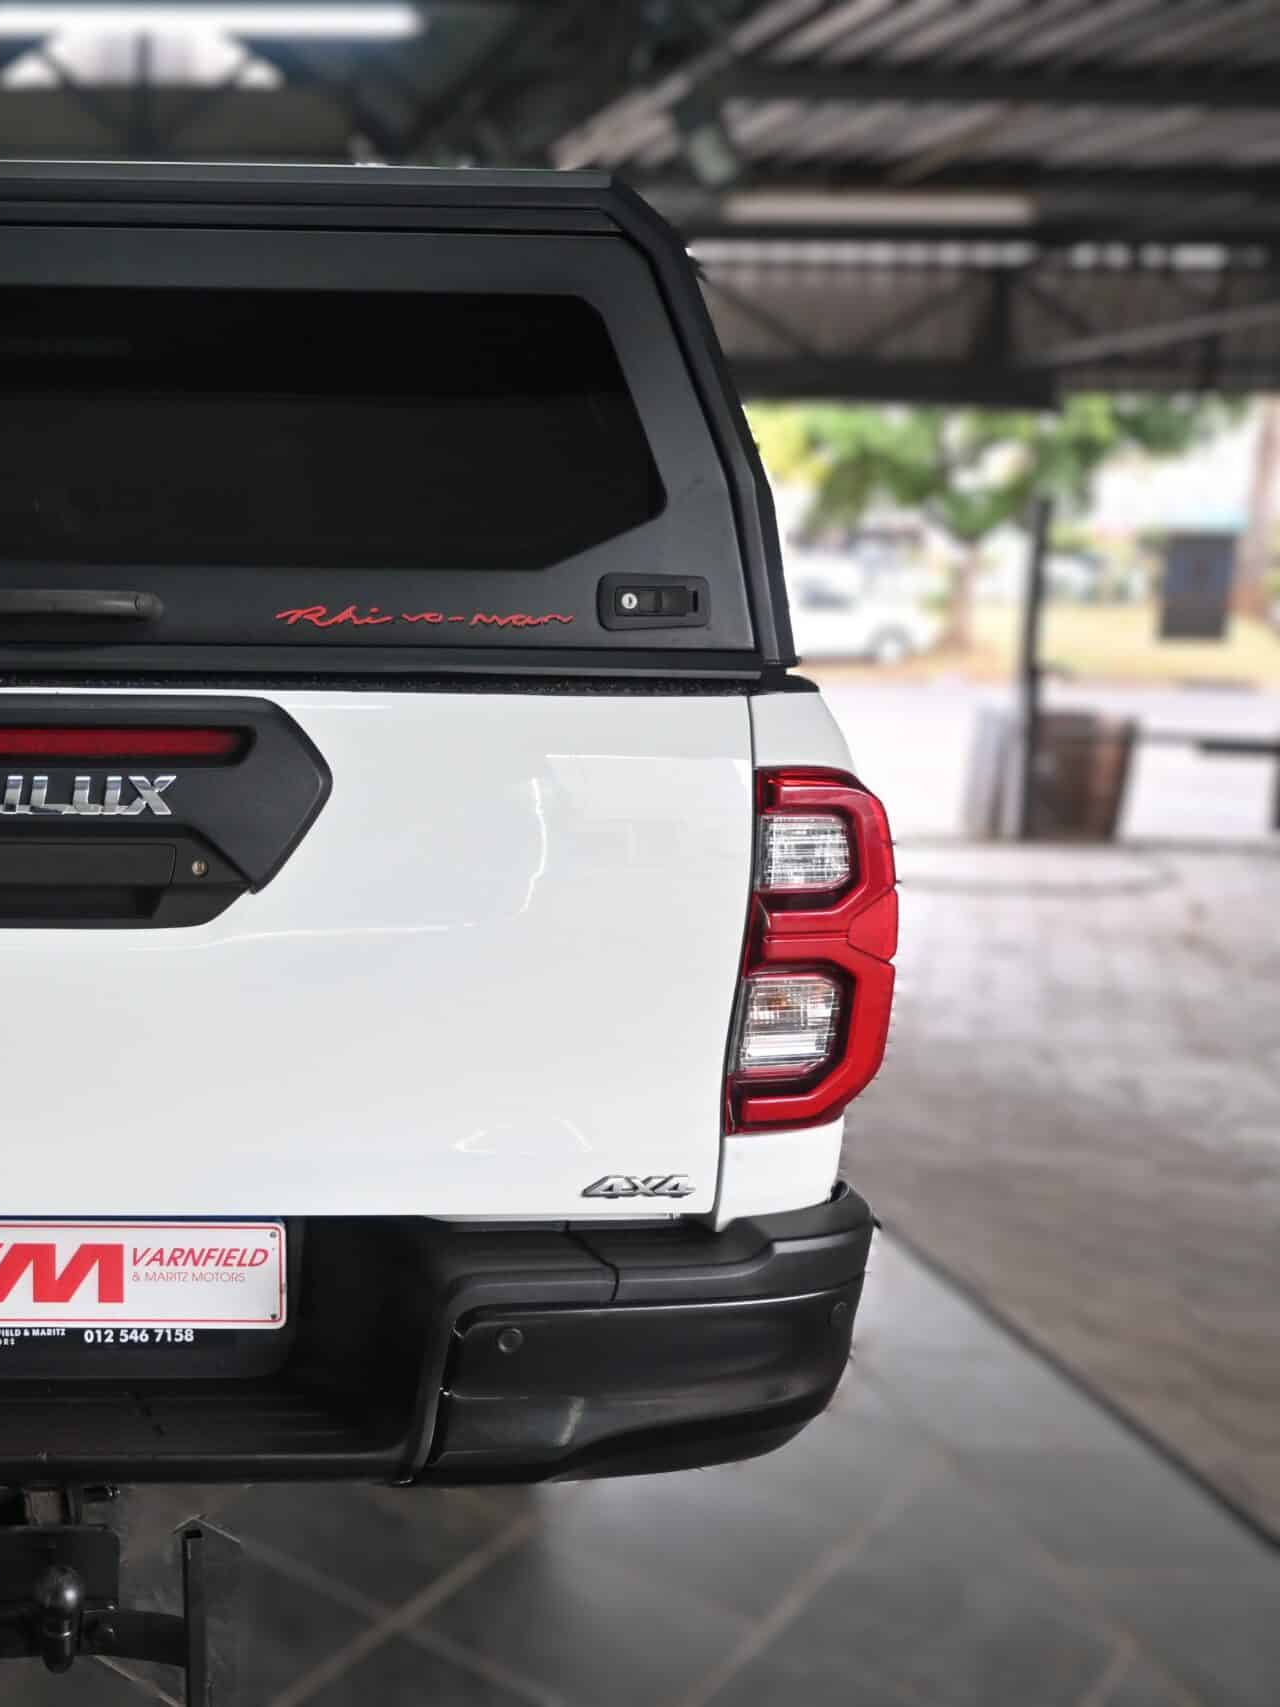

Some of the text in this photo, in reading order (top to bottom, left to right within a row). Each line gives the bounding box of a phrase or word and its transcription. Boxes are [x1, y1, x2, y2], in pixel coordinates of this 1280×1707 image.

[131, 1246, 270, 1268] VARNFIELD
[131, 1271, 246, 1283] & MARITZ MOTORS
[24, 1328, 30, 1337] &
[32, 1327, 67, 1337] MARITZ
[83, 1328, 195, 1343] 012 546 7158
